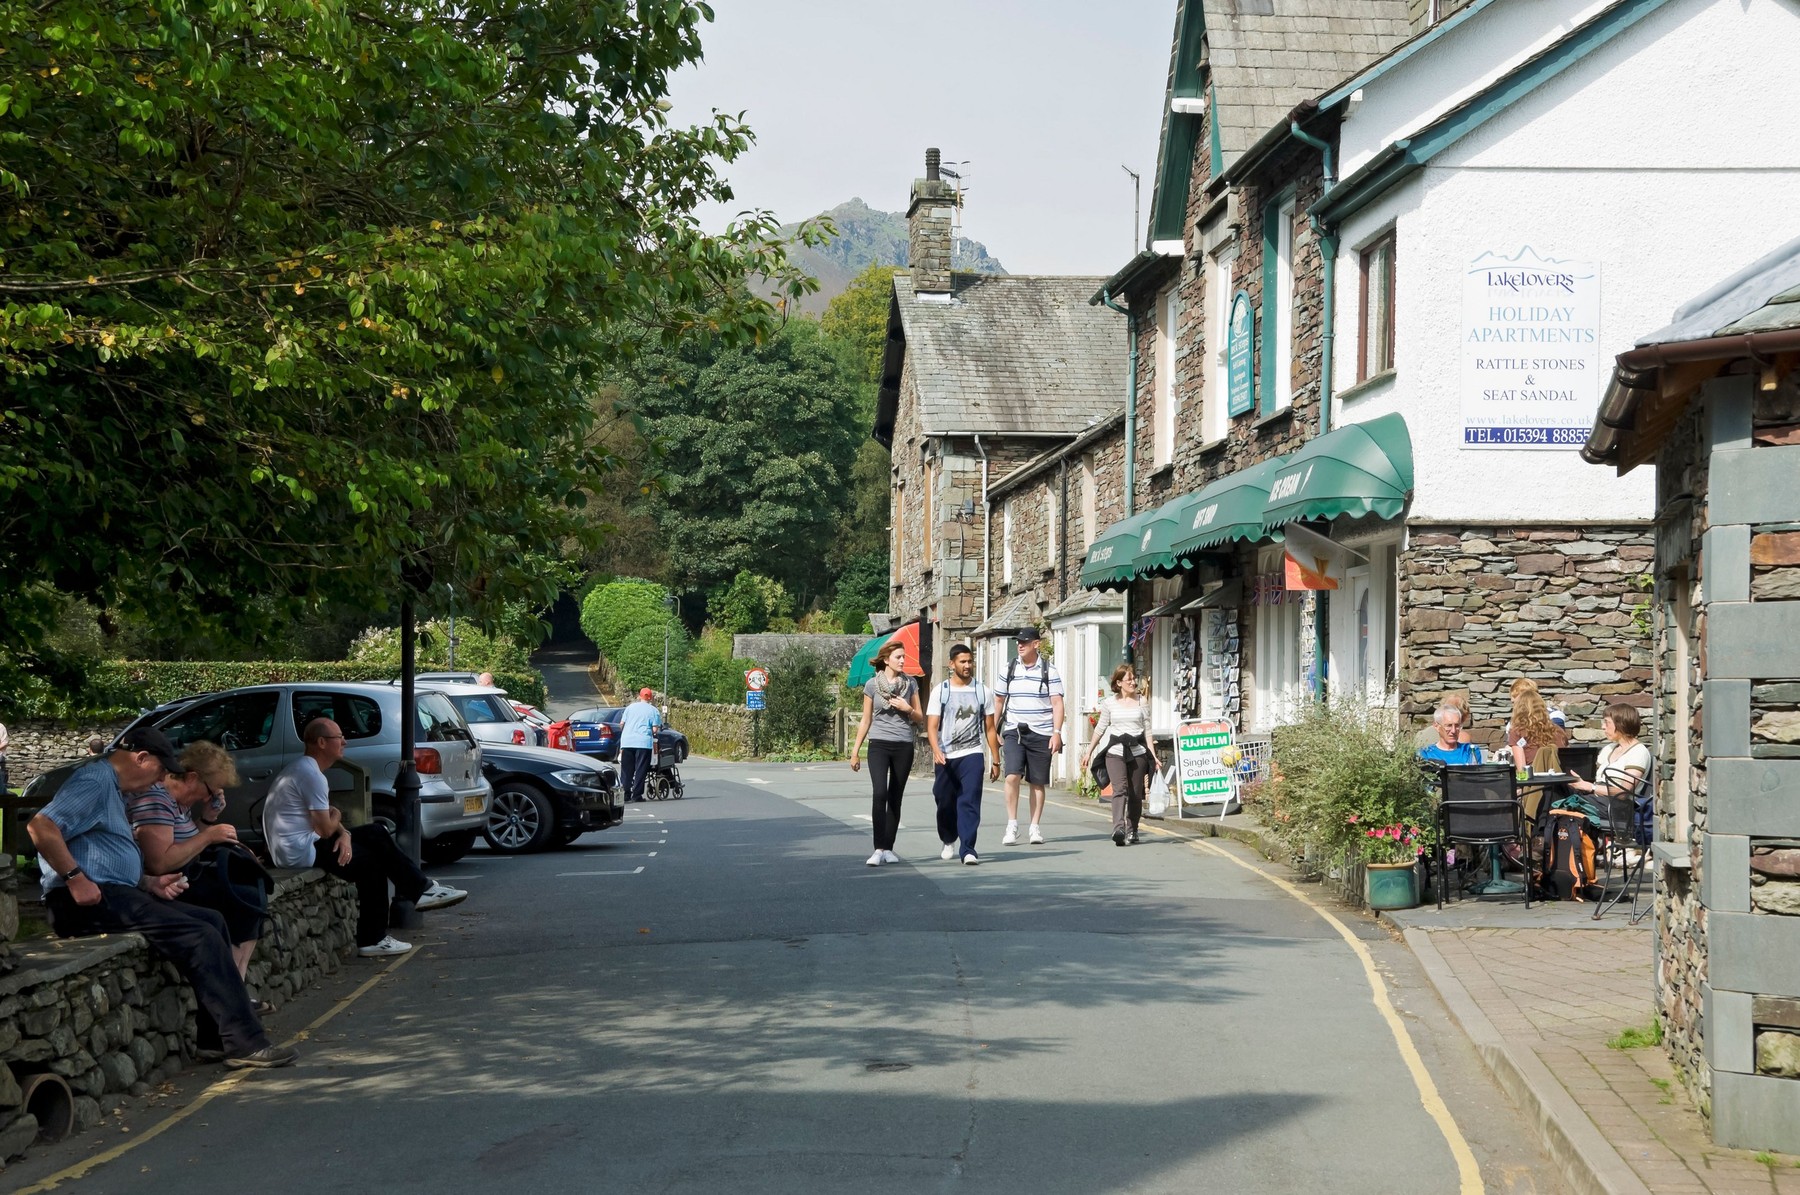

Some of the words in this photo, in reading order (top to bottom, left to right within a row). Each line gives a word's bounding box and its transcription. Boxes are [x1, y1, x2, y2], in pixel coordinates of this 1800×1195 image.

[1489, 306, 1575, 321] HOLIDAY
[1467, 327, 1595, 343] APARTMENTS
[1475, 358, 1529, 370] RATTLE
[1532, 358, 1586, 370] STONES
[1524, 374, 1536, 386] &
[1483, 389, 1517, 401] SEAT
[1520, 389, 1578, 401] SANDAL
[1466, 414, 1593, 425] www.lakelovers.co.uk
[1468, 428, 1500, 442] TEL:
[1503, 428, 1548, 443] 015394
[1187, 726, 1203, 735] We
[1180, 736, 1228, 748] FUJIFILM
[1183, 757, 1210, 768] Single
[1184, 780, 1230, 792] FUJIFILM
